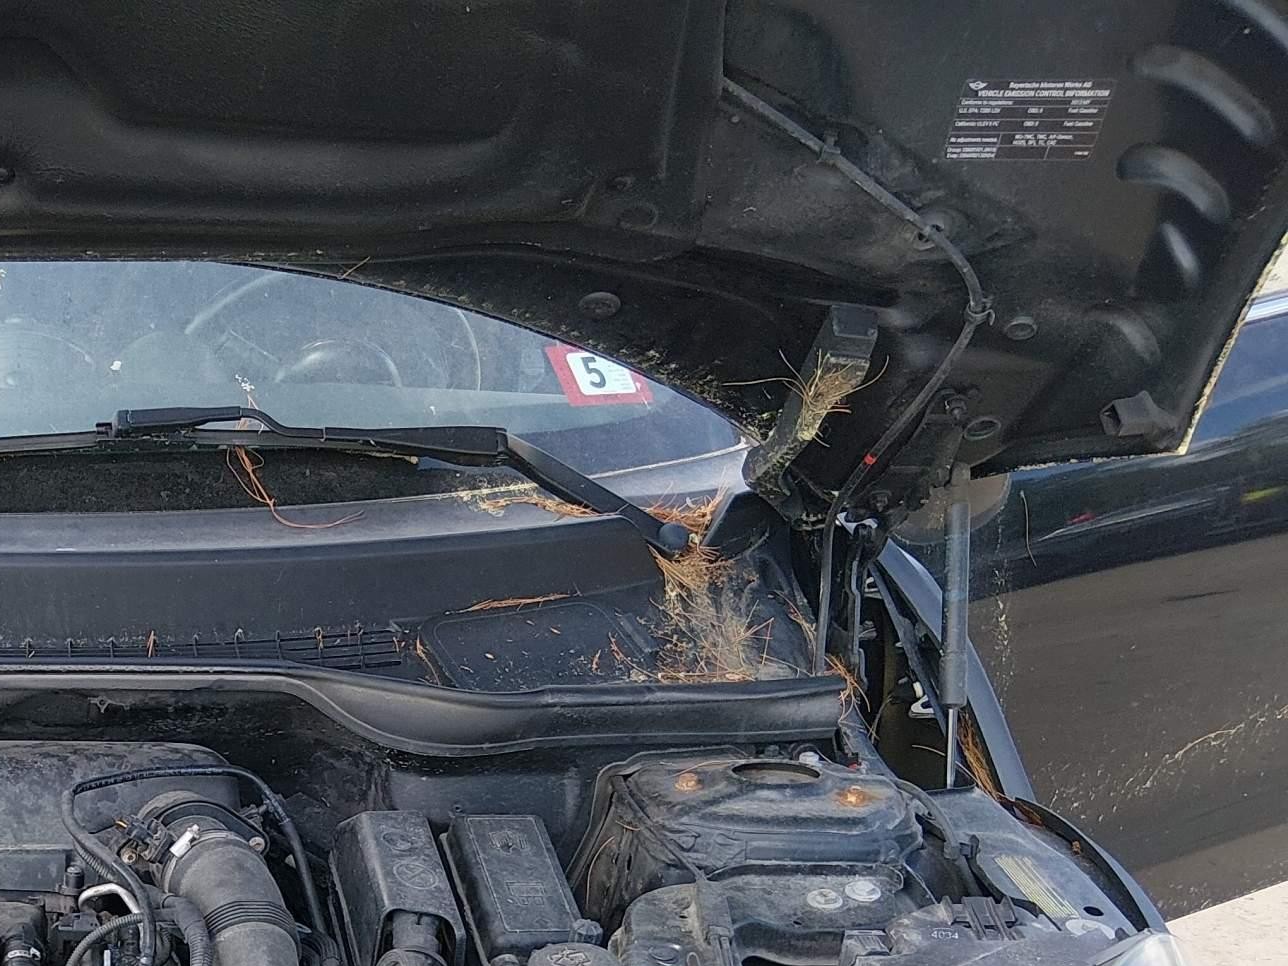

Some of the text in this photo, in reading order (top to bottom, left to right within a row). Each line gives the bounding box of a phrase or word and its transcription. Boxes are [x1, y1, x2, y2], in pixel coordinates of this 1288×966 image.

[978, 89, 1110, 97] VEHICLE EMISSION CONTROL INFORMATION
[580, 356, 607, 389] 5
